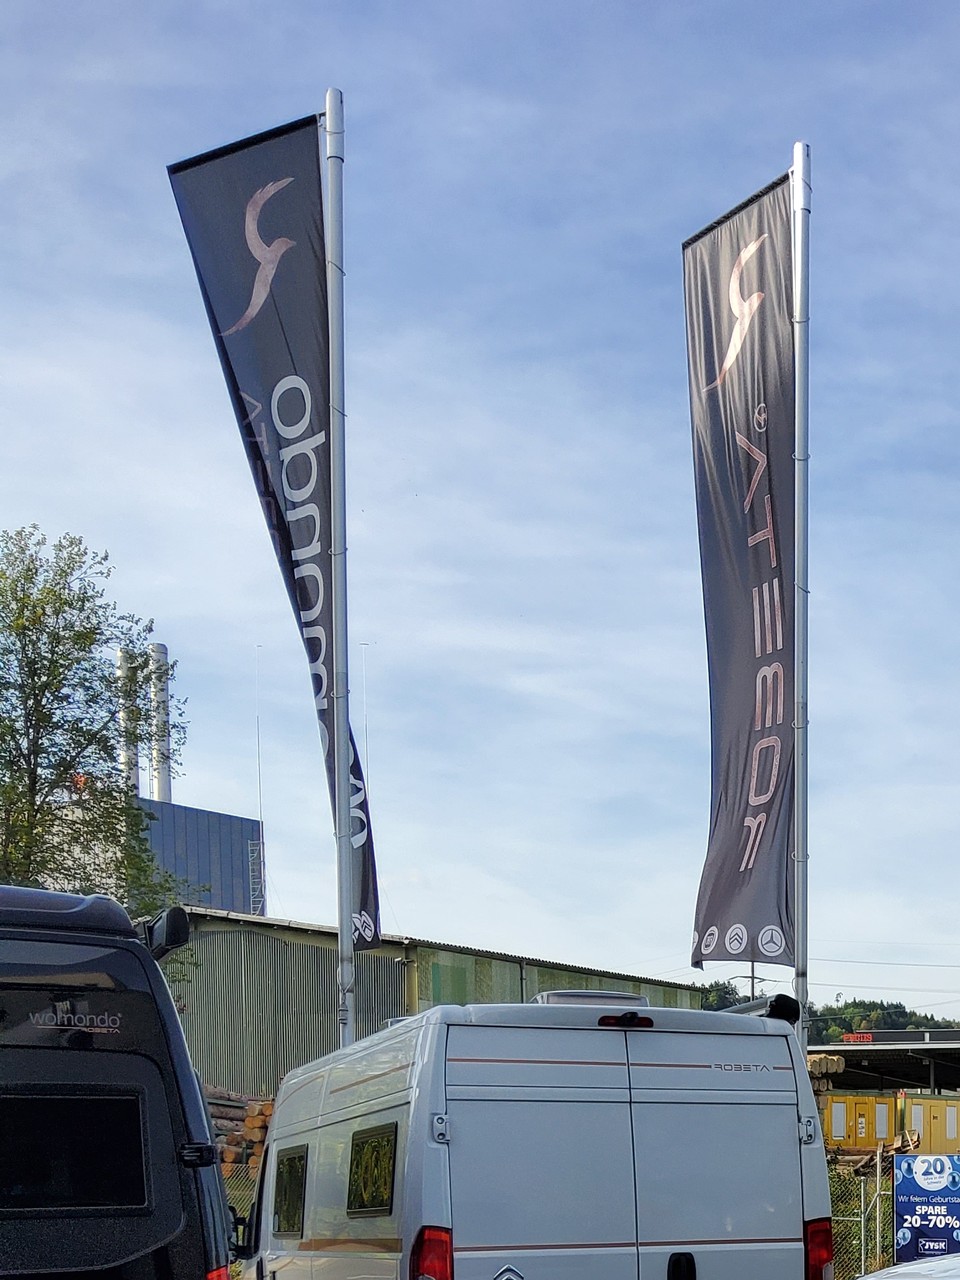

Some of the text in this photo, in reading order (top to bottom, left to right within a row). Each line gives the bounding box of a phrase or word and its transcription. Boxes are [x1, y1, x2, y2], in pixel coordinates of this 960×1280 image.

[714, 1063, 770, 1072] ROBETA
[921, 1157, 945, 1177] 20
[898, 1195, 909, 1203] Wir
[915, 1206, 948, 1215] SPARE
[924, 1242, 946, 1250] JYSK
